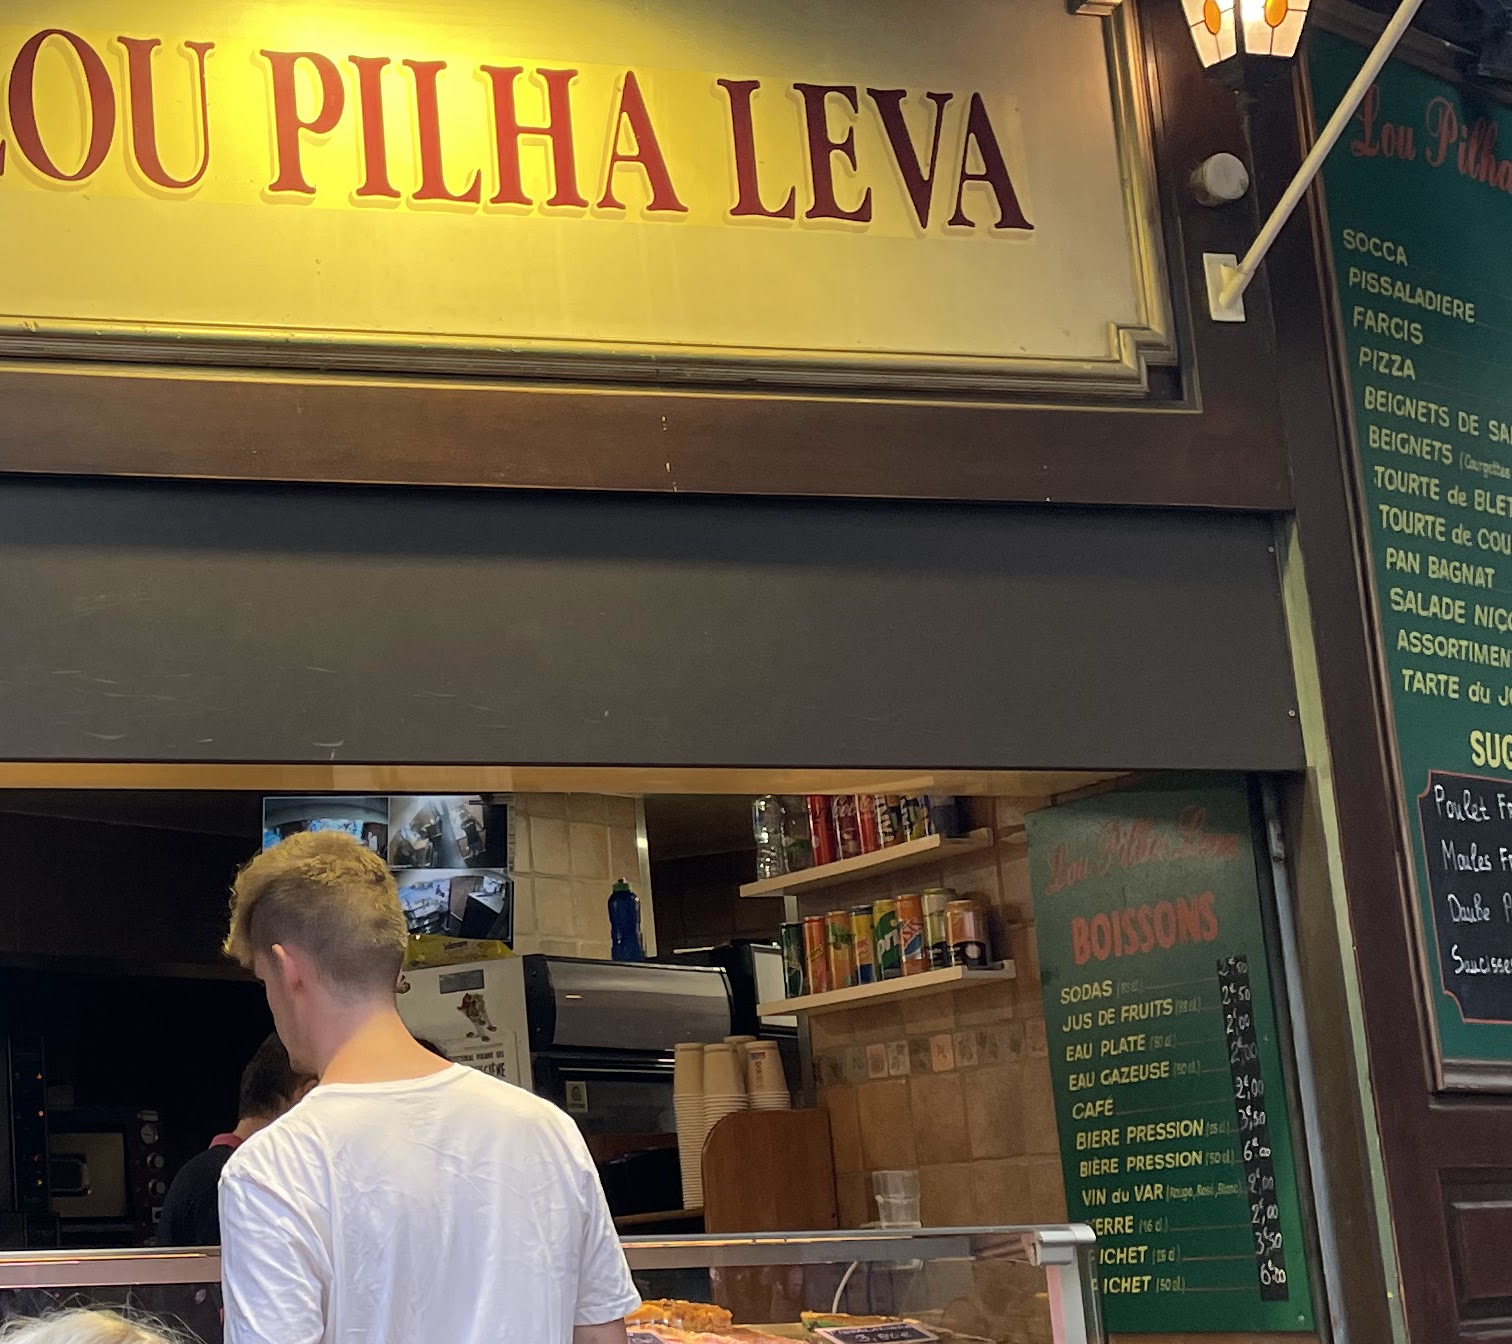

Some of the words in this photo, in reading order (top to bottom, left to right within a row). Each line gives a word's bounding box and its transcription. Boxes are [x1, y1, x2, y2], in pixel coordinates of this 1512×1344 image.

[259, 49, 690, 214] PILHA
[714, 79, 1037, 233] LEVA
[1343, 228, 1409, 268] SOCCA
[1352, 305, 1424, 346] FARCIS
[1358, 346, 1416, 380] PIZZA
[1364, 386, 1450, 427] BEIGNETS
[1458, 411, 1479, 436] DE
[1369, 425, 1453, 465] BEIGNETS
[1374, 466, 1440, 501] TOURTE
[1448, 485, 1467, 507] de
[1379, 504, 1446, 542] TOURTE
[1452, 523, 1472, 546] de
[1386, 547, 1420, 574] PAN
[1428, 556, 1496, 589] BAGNAT
[1390, 587, 1466, 624] SALADE
[1397, 629, 1512, 668] ASSORTIMEN
[1402, 669, 1460, 699] TARTE
[1468, 680, 1490, 704] du
[1071, 891, 1219, 966] BOISSONS
[1061, 980, 1113, 1004] SODAS
[1062, 1013, 1093, 1033] JUS
[1098, 1009, 1115, 1026] DE
[1121, 999, 1173, 1022] FRUITS
[1066, 1043, 1093, 1061] EAU
[1101, 1034, 1146, 1056] PLATE
[1069, 1072, 1095, 1091] EAU
[1101, 1061, 1170, 1085] GAZEUSE
[1127, 1119, 1204, 1144] PRESSION
[1127, 1151, 1203, 1172] PRESSION
[1082, 1189, 1106, 1206] VIN
[1112, 1188, 1130, 1204] du
[1135, 1184, 1163, 1202] VAR
[1091, 1216, 1134, 1236] ERRE
